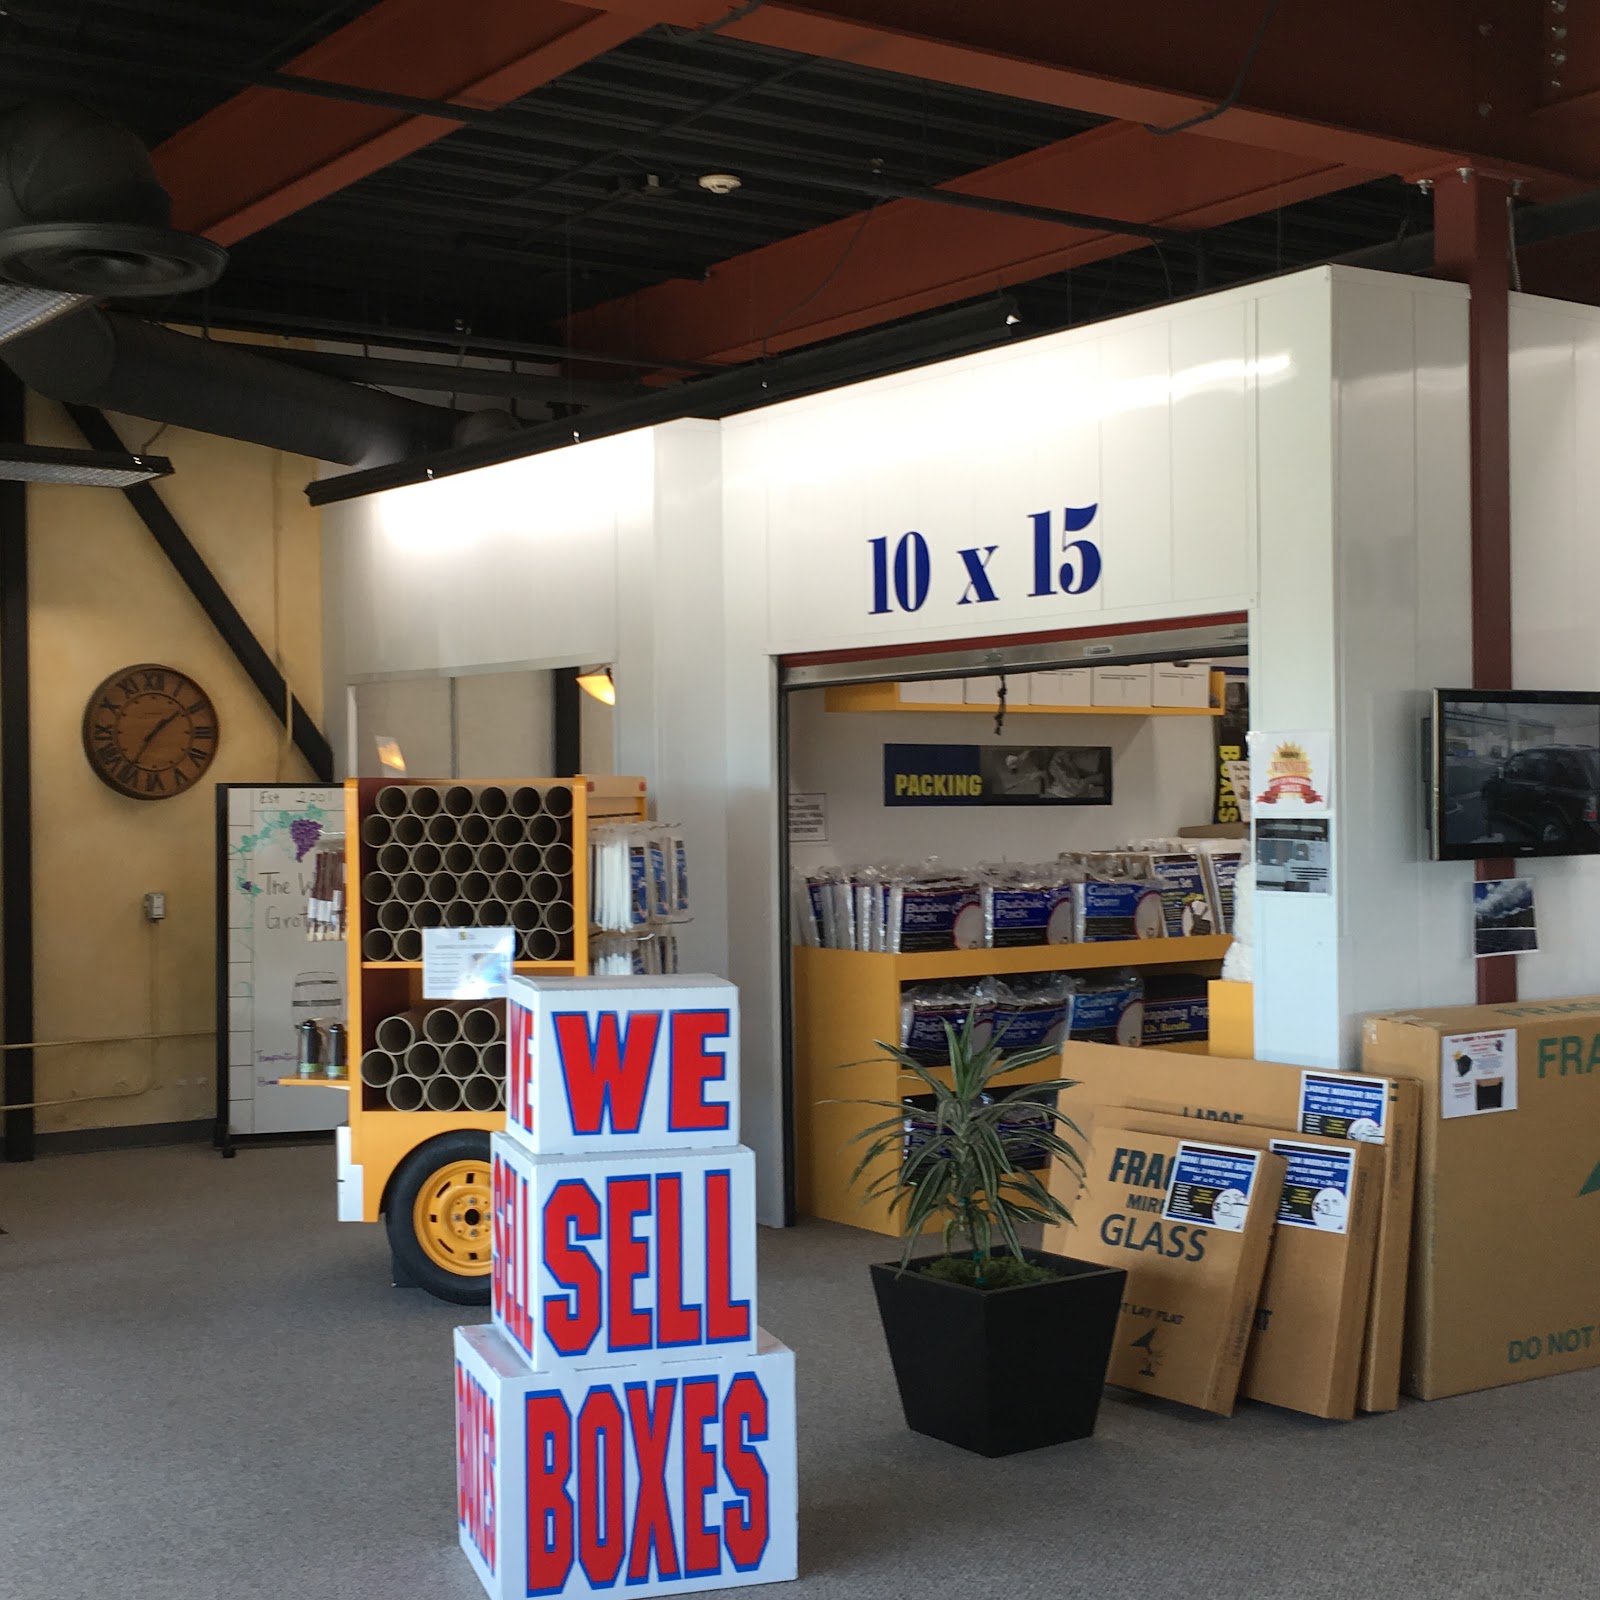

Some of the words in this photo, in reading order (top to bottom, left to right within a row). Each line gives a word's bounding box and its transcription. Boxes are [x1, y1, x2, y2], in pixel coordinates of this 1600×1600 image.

[867, 531, 931, 615] 10
[956, 545, 1000, 605] x
[1027, 503, 1101, 597] 15
[895, 774, 983, 797] PACKING
[259, 872, 290, 896] The
[905, 913, 938, 924] Pack
[996, 909, 1028, 919] Pack
[551, 1008, 730, 1135] WE
[1100, 1213, 1208, 1262] GLASS
[543, 1169, 752, 1358] SELL
[1508, 1335, 1541, 1364] DO
[1547, 1325, 1595, 1355] NOT
[525, 1371, 769, 1598] BOXES
